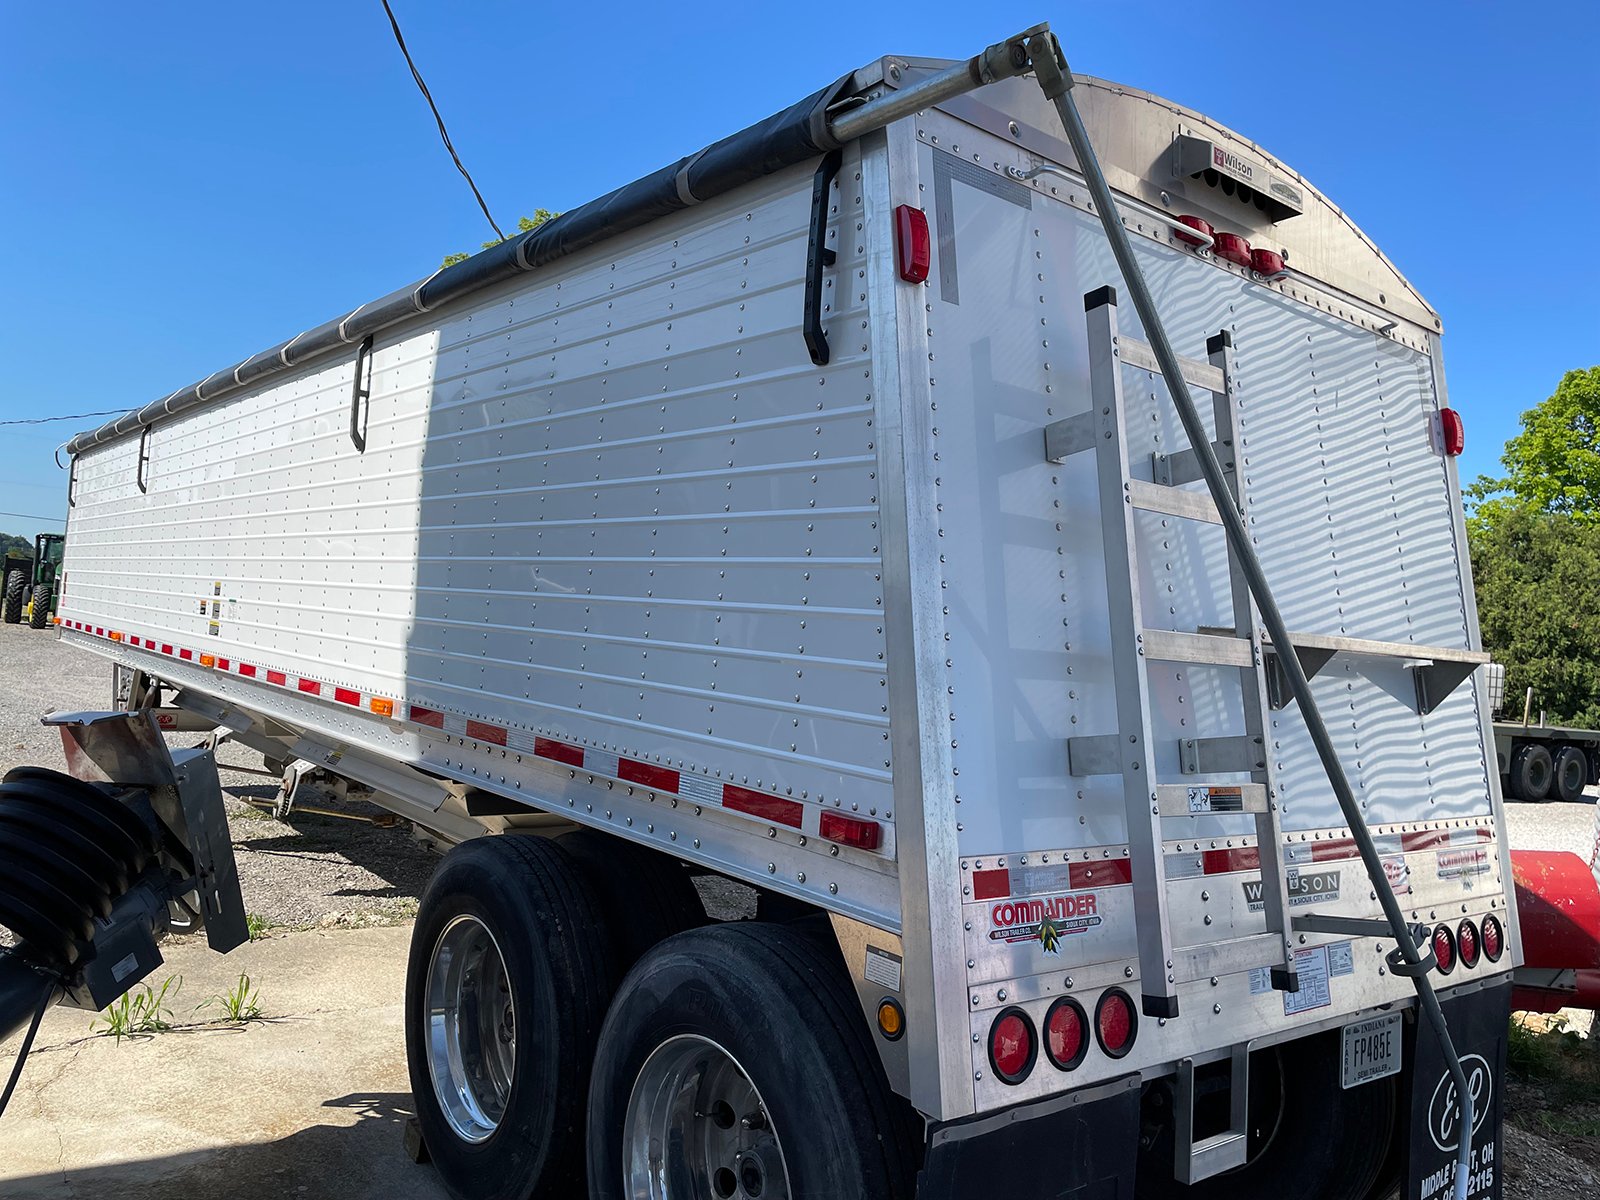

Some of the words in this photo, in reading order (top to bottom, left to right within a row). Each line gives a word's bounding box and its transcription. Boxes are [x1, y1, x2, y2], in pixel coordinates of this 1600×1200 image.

[1224, 151, 1253, 177] Wilson
[992, 894, 1097, 927] COMMANDER
[994, 930, 1010, 938] WILSON
[1010, 928, 1025, 936] TRAILER
[1361, 1020, 1385, 1034] INDIANA
[1354, 1031, 1392, 1068] FP485E
[1369, 1064, 1388, 1075] TRAILER
[1420, 1163, 1450, 1200] MIDDLE
[1481, 1141, 1494, 1165] OH
